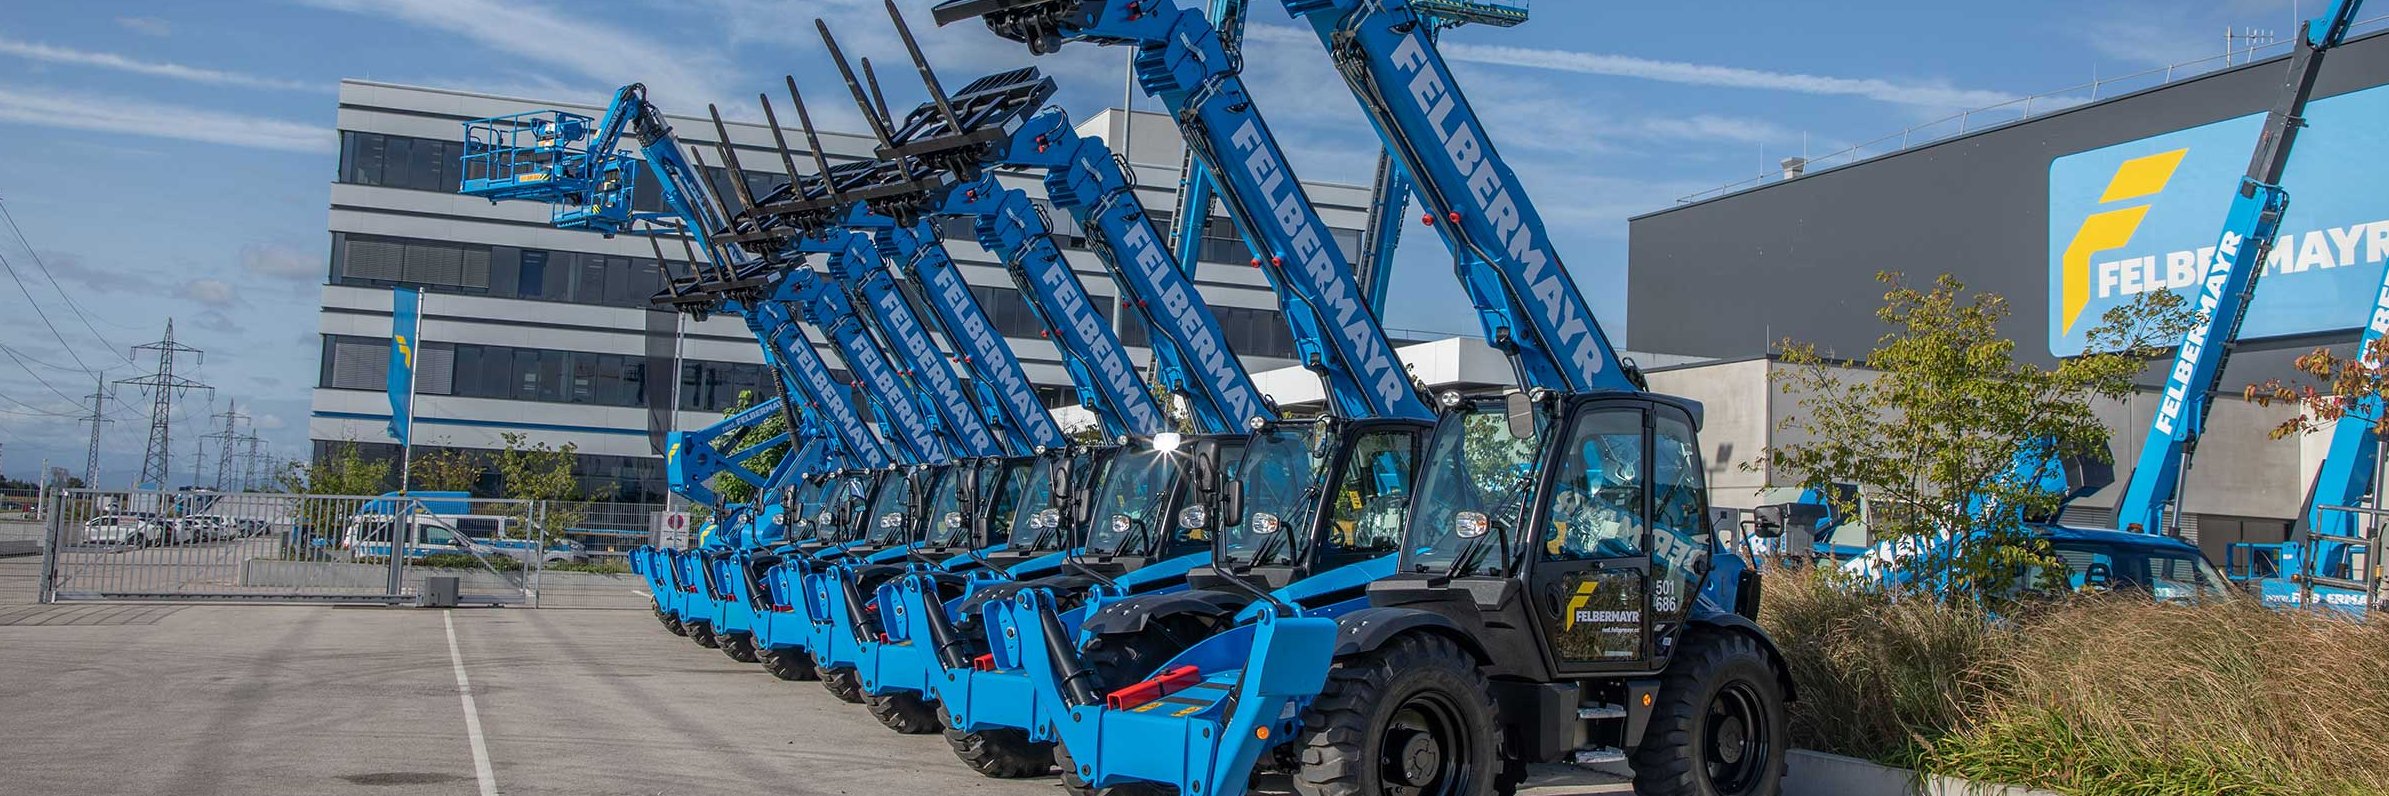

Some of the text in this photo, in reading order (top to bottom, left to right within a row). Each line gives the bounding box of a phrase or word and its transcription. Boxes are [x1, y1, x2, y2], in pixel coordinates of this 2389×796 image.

[1231, 118, 1403, 415] FELBERMAYR
[1390, 33, 1603, 391] FELBERMAYR
[2098, 220, 2389, 298] FELBEMAYR
[850, 334, 945, 464] FELBERMAY
[879, 291, 989, 456] FELBERMAYR
[933, 266, 1053, 445] FELBERMAYR
[1042, 262, 1158, 434] FELBERMA
[1124, 222, 1256, 433] FELBERMAY
[789, 338, 881, 466] FELBERMAYR
[1576, 610, 1640, 622] FELBERMAYR
[1656, 580, 1675, 595] 501
[1656, 597, 1676, 612] 686
